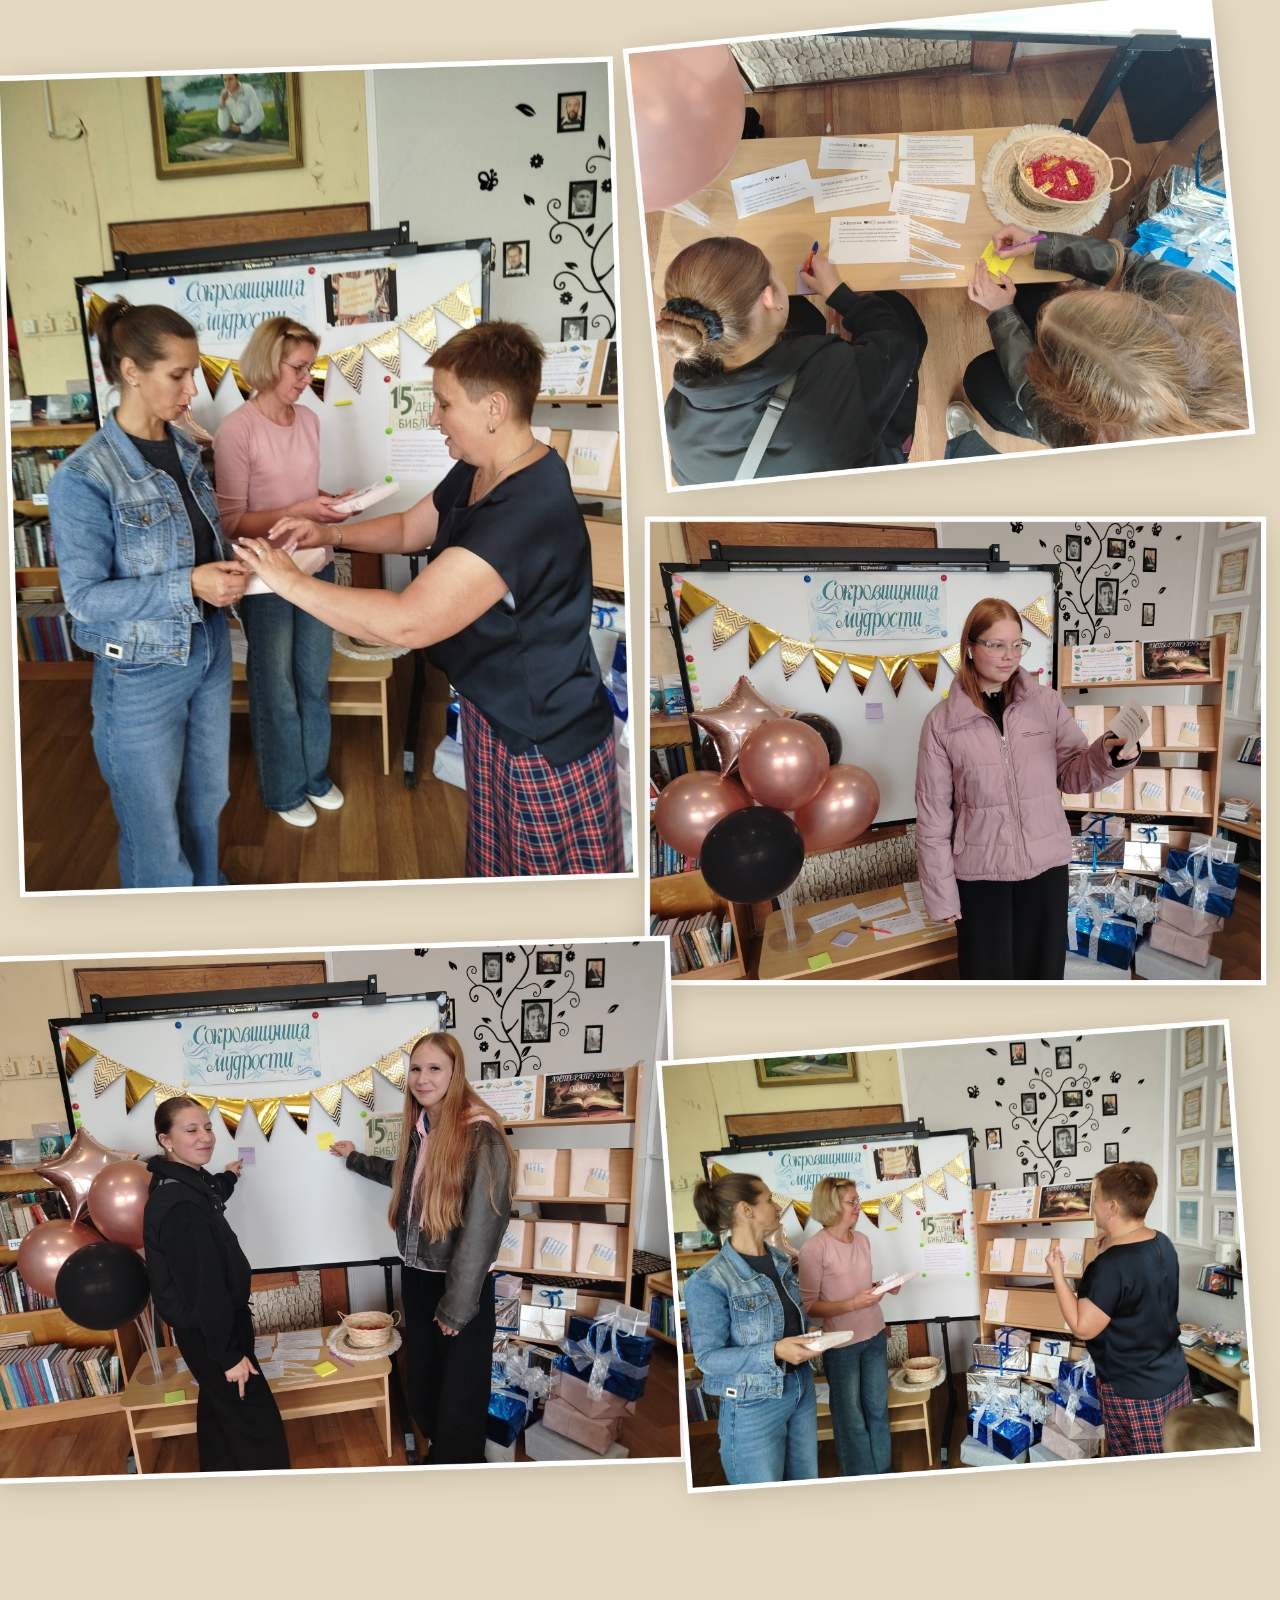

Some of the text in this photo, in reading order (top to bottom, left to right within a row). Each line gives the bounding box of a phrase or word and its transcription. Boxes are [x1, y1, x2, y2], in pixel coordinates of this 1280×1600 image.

[186, 279, 304, 308] Сокровищница
[390, 386, 413, 415] 15
[414, 400, 436, 415] ДЕН
[822, 580, 939, 607] Сокровищница
[835, 610, 922, 637] мудрости
[193, 1023, 311, 1050] Сокровищница
[206, 1051, 294, 1080] мудрости
[366, 1118, 385, 1145] 15
[781, 1151, 861, 1171] Сокровищница
[920, 1216, 935, 1235] 15
